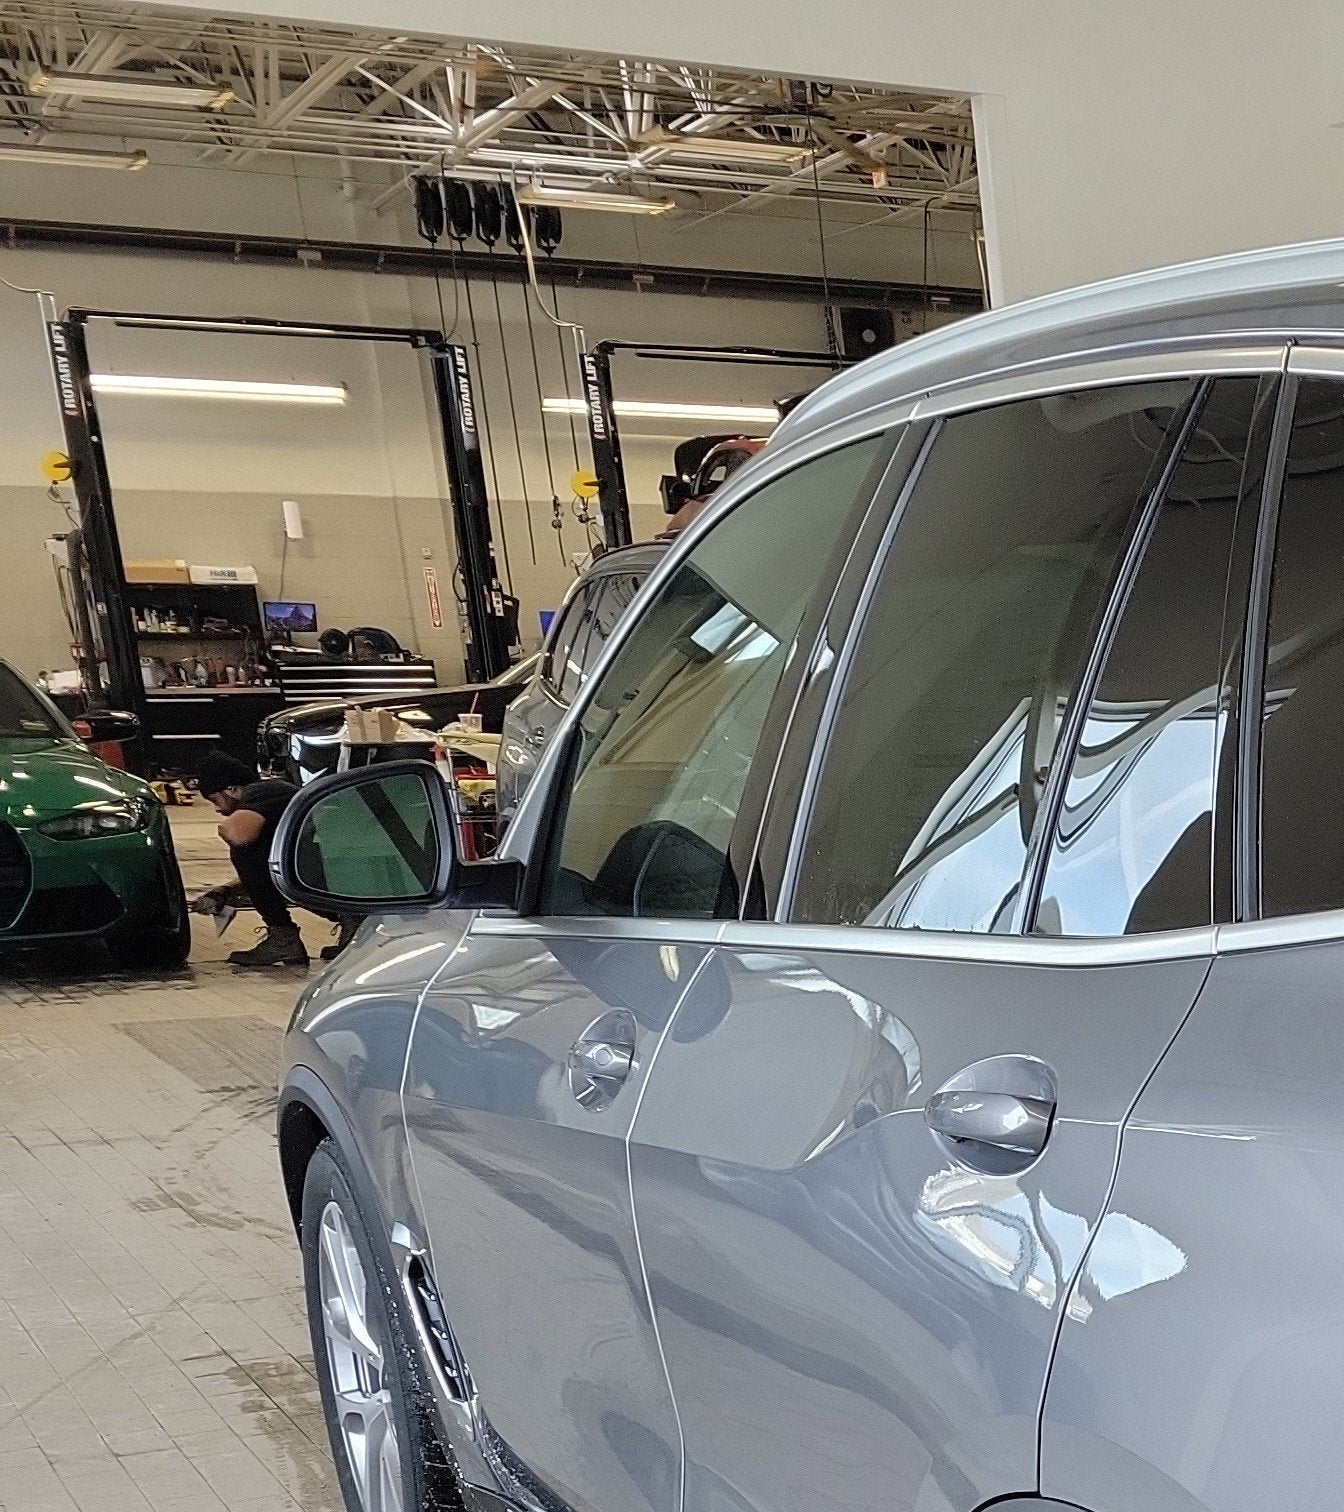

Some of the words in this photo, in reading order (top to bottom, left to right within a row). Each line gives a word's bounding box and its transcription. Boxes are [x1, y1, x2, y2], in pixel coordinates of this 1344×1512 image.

[51, 323, 67, 351] LIFT
[56, 355, 77, 408] ROTARY
[584, 354, 598, 381] LIFT
[459, 376, 474, 425] ROTARY
[588, 384, 604, 432] ROTARY
